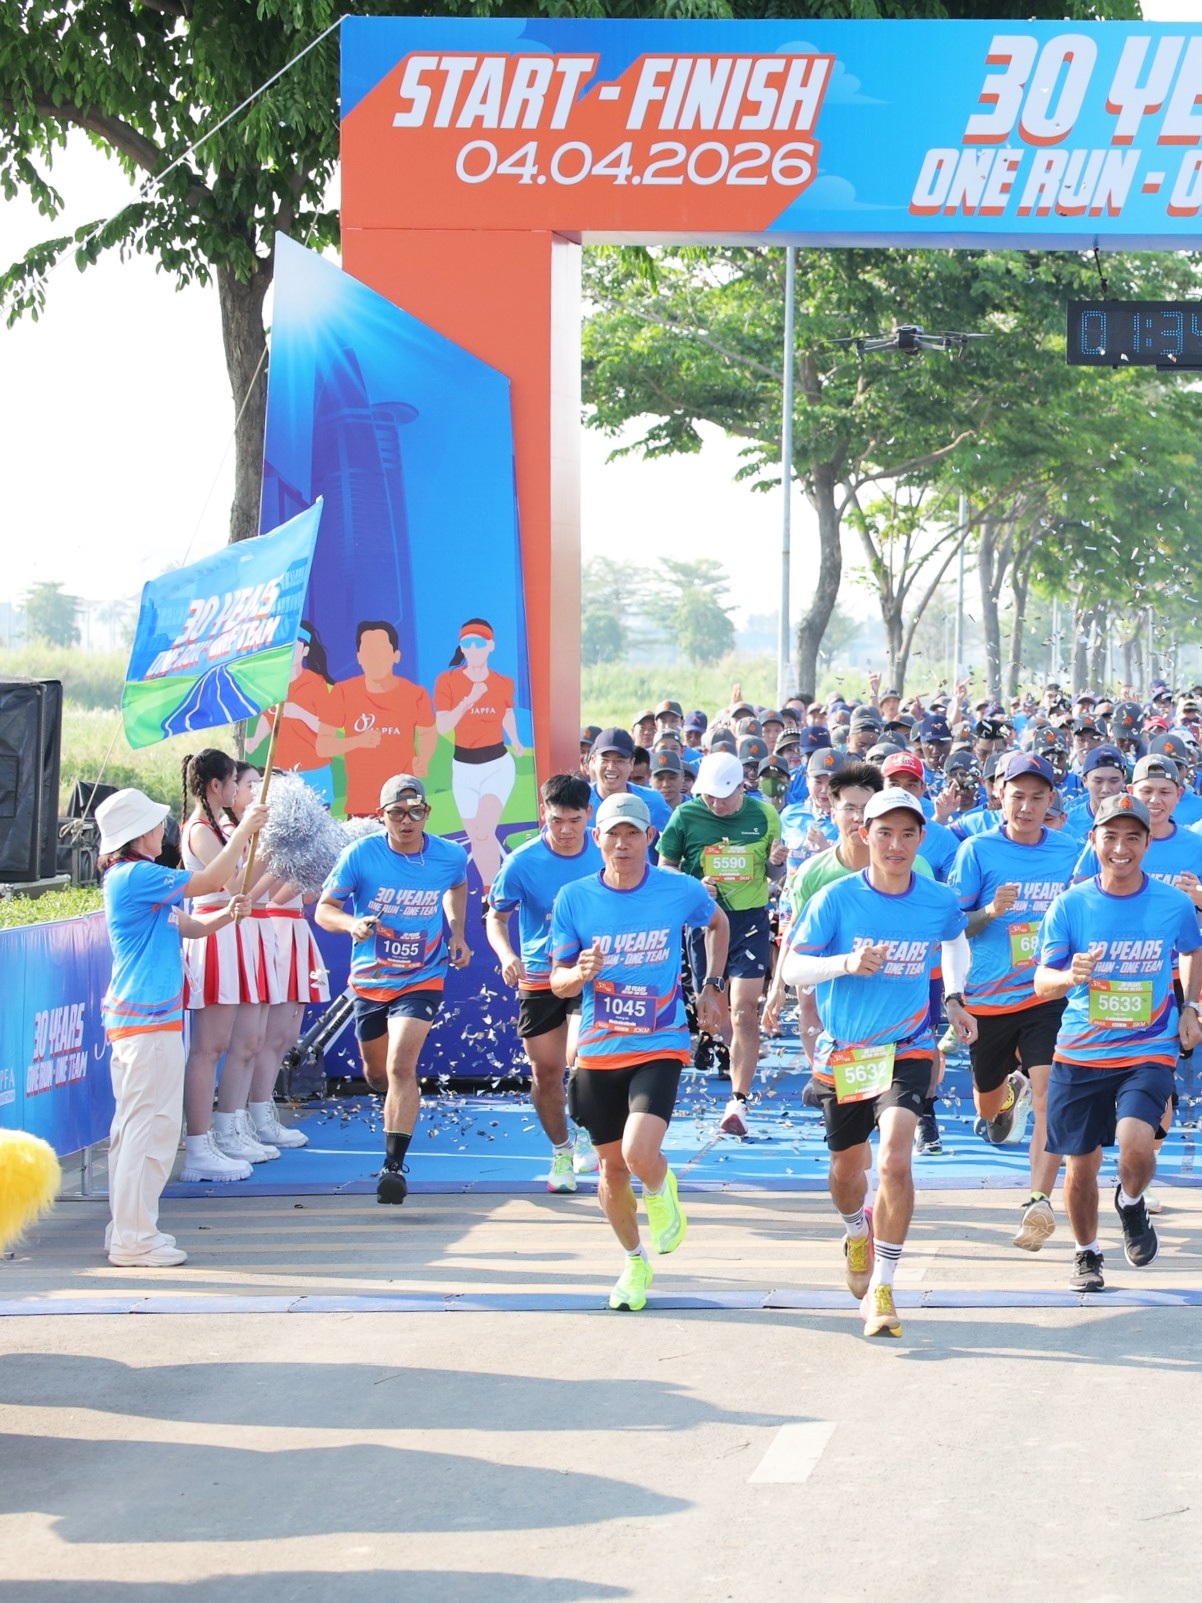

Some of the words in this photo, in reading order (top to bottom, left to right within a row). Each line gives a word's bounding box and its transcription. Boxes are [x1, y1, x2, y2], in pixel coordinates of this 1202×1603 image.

[393, 56, 592, 130] START
[599, 86, 620, 100] -
[626, 57, 830, 131] FINISH
[964, 33, 1098, 146] 30
[456, 140, 814, 186] 04.04.2026
[909, 148, 1019, 216] ONE
[1018, 148, 1143, 217] RUN
[172, 595, 219, 648] 30
[470, 707, 496, 715] JAPFA
[713, 857, 746, 869] 5590
[375, 887, 393, 904] 30
[396, 889, 439, 906] YEARS
[403, 906, 419, 917] ONE
[384, 940, 419, 956] 1055
[614, 929, 670, 955] YEARS
[1110, 940, 1164, 962] YEARS
[624, 953, 645, 966] ONE
[645, 947, 670, 963] TEAM
[884, 962, 905, 976] ONE
[1094, 961, 1115, 975] RUN
[1120, 961, 1141, 975] ONE
[1141, 960, 1164, 973] TEAM
[604, 997, 646, 1017] 1045
[1098, 995, 1142, 1012] 5633
[33, 1010, 49, 1062] 30
[49, 1003, 85, 1058] YEARS
[845, 1061, 887, 1084] 5632
